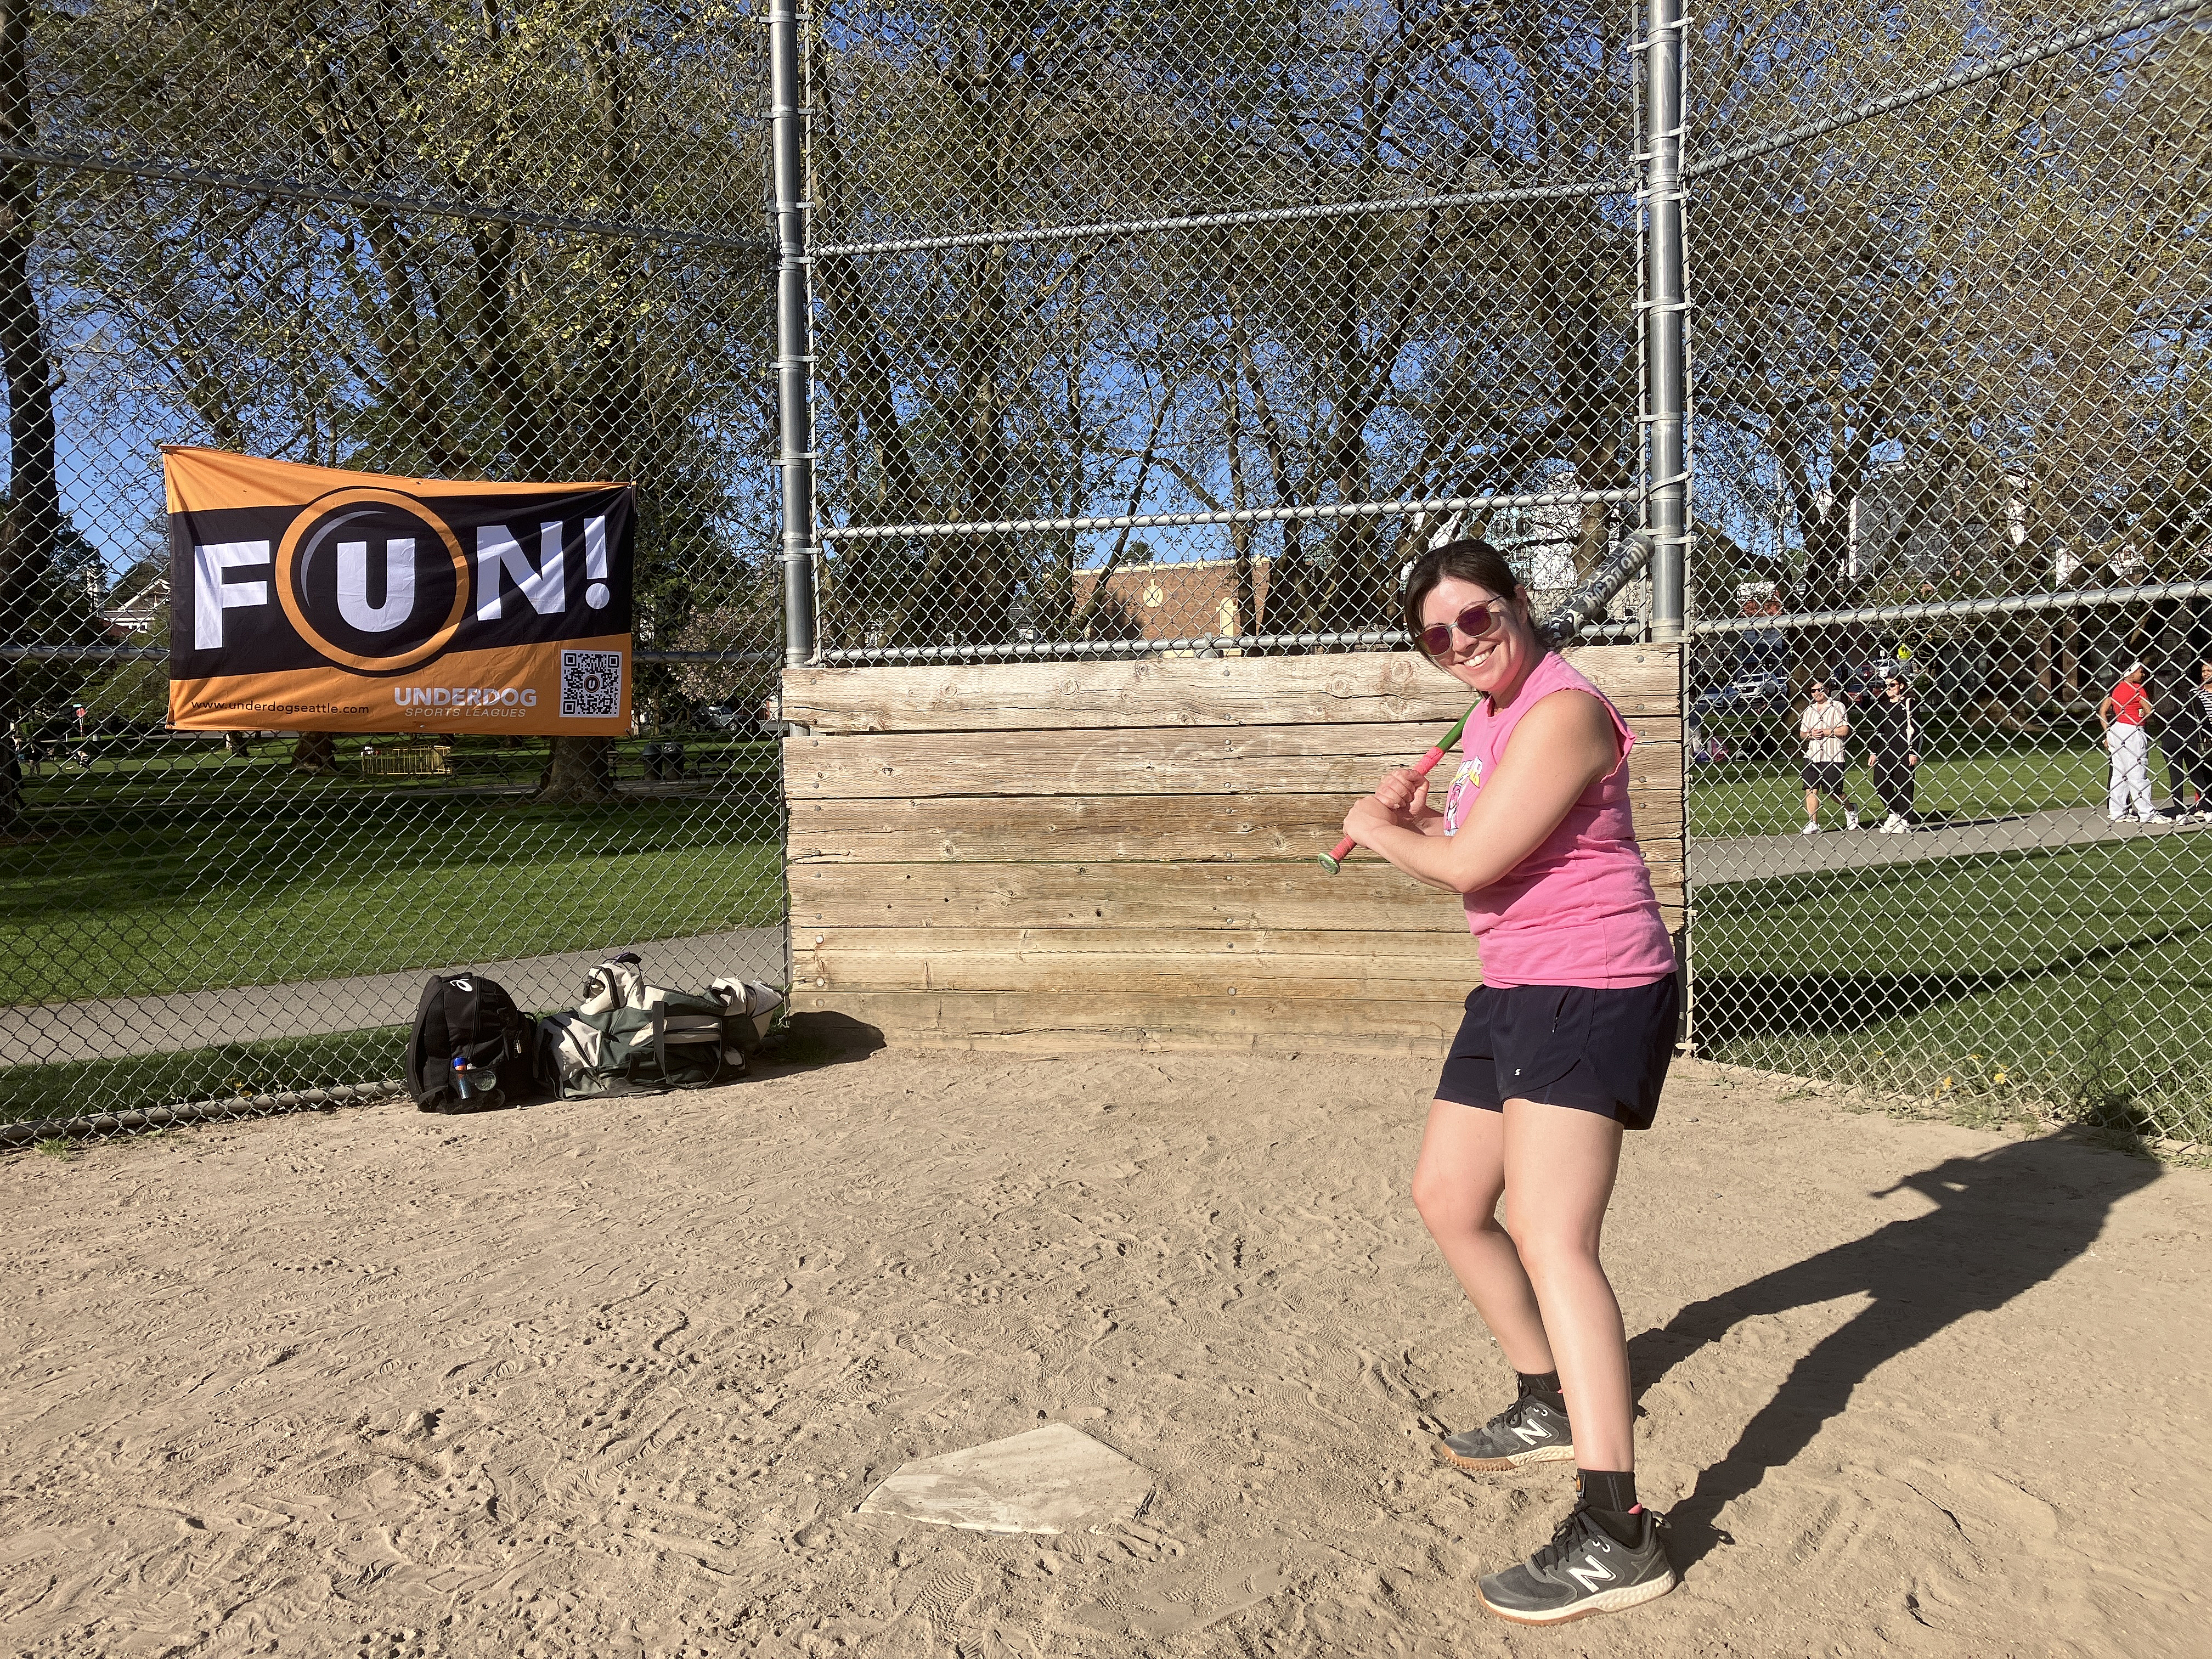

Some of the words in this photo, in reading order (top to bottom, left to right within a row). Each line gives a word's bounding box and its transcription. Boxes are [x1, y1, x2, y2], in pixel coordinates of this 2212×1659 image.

[194, 515, 610, 651] FUN!
[191, 700, 369, 714] www.underdogseattle.com
[394, 687, 537, 707] UNDERDOG
[405, 708, 461, 716] SPORTS
[466, 708, 526, 718] LEAGUES
[1510, 1418, 1552, 1445] N
[1568, 1554, 1617, 1593] N
